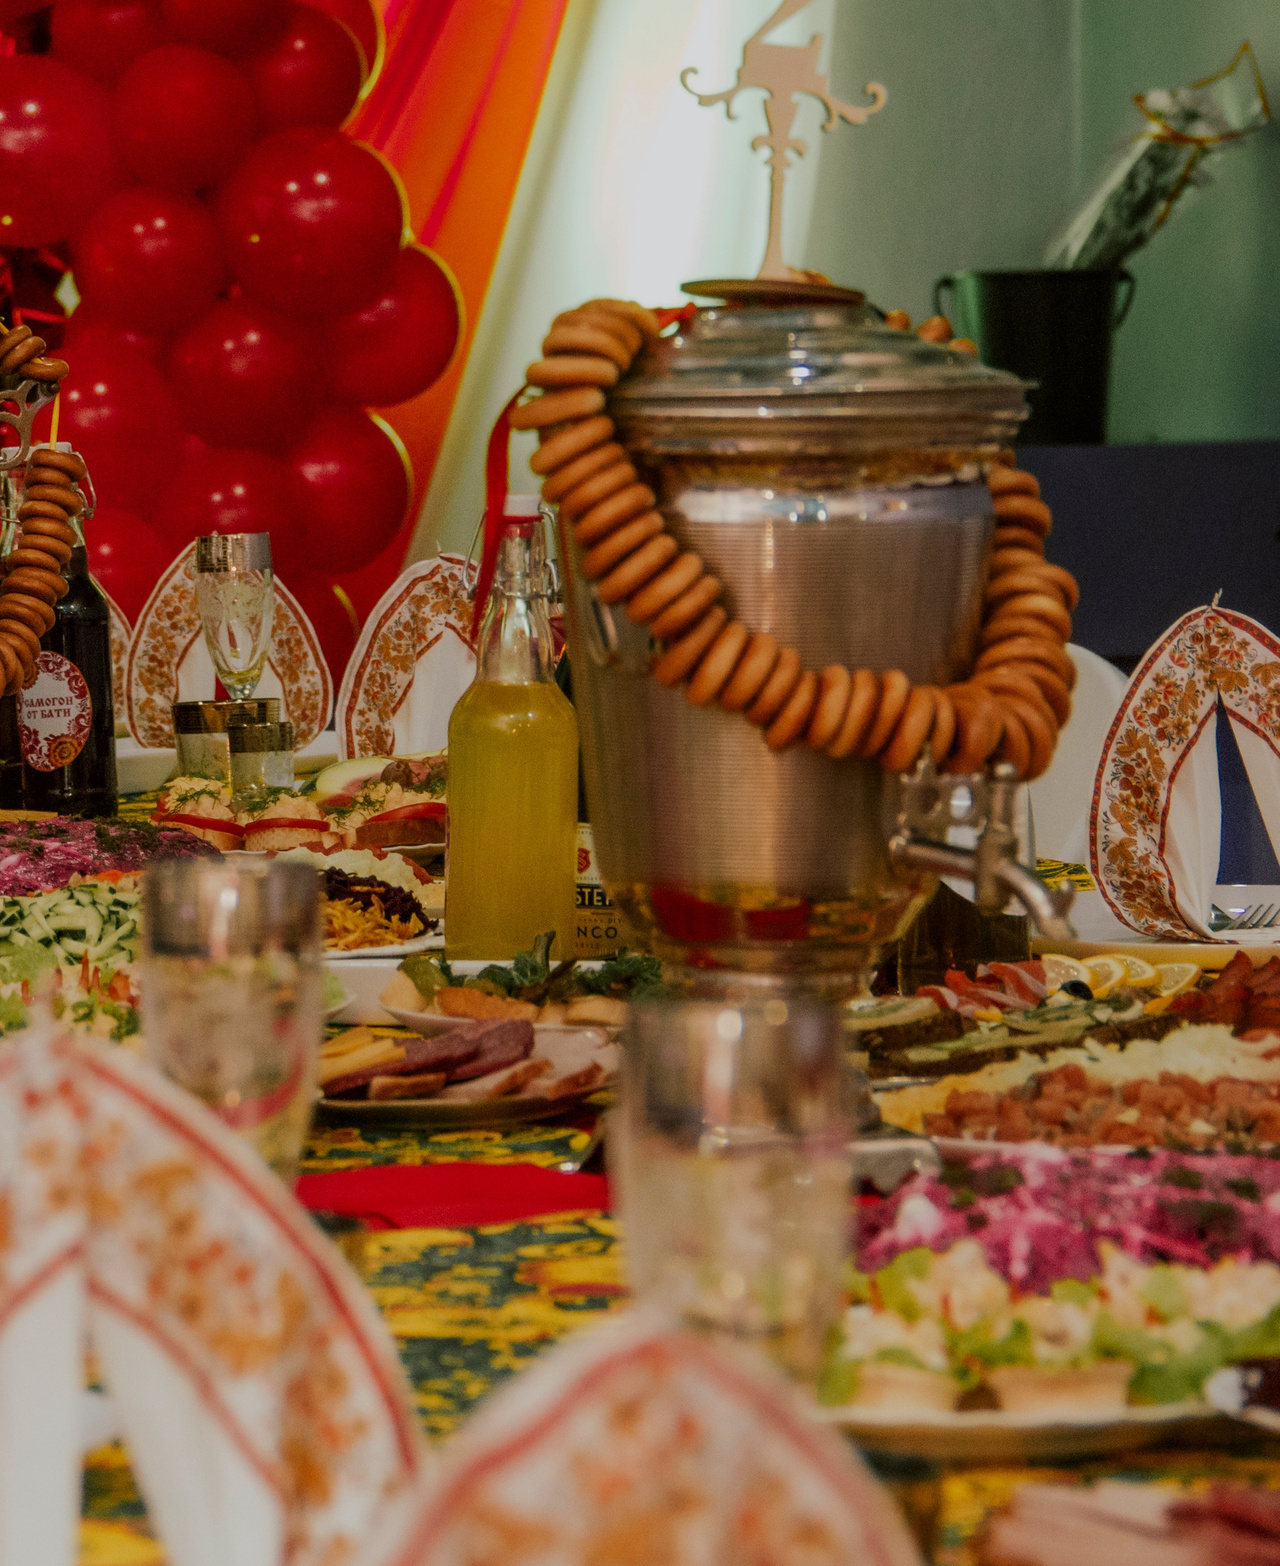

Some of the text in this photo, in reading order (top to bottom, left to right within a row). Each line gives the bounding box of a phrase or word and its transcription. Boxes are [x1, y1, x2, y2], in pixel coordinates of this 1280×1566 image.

[24, 697, 73, 708] САМОГОН
[27, 708, 71, 719] ОТ БАТИ
